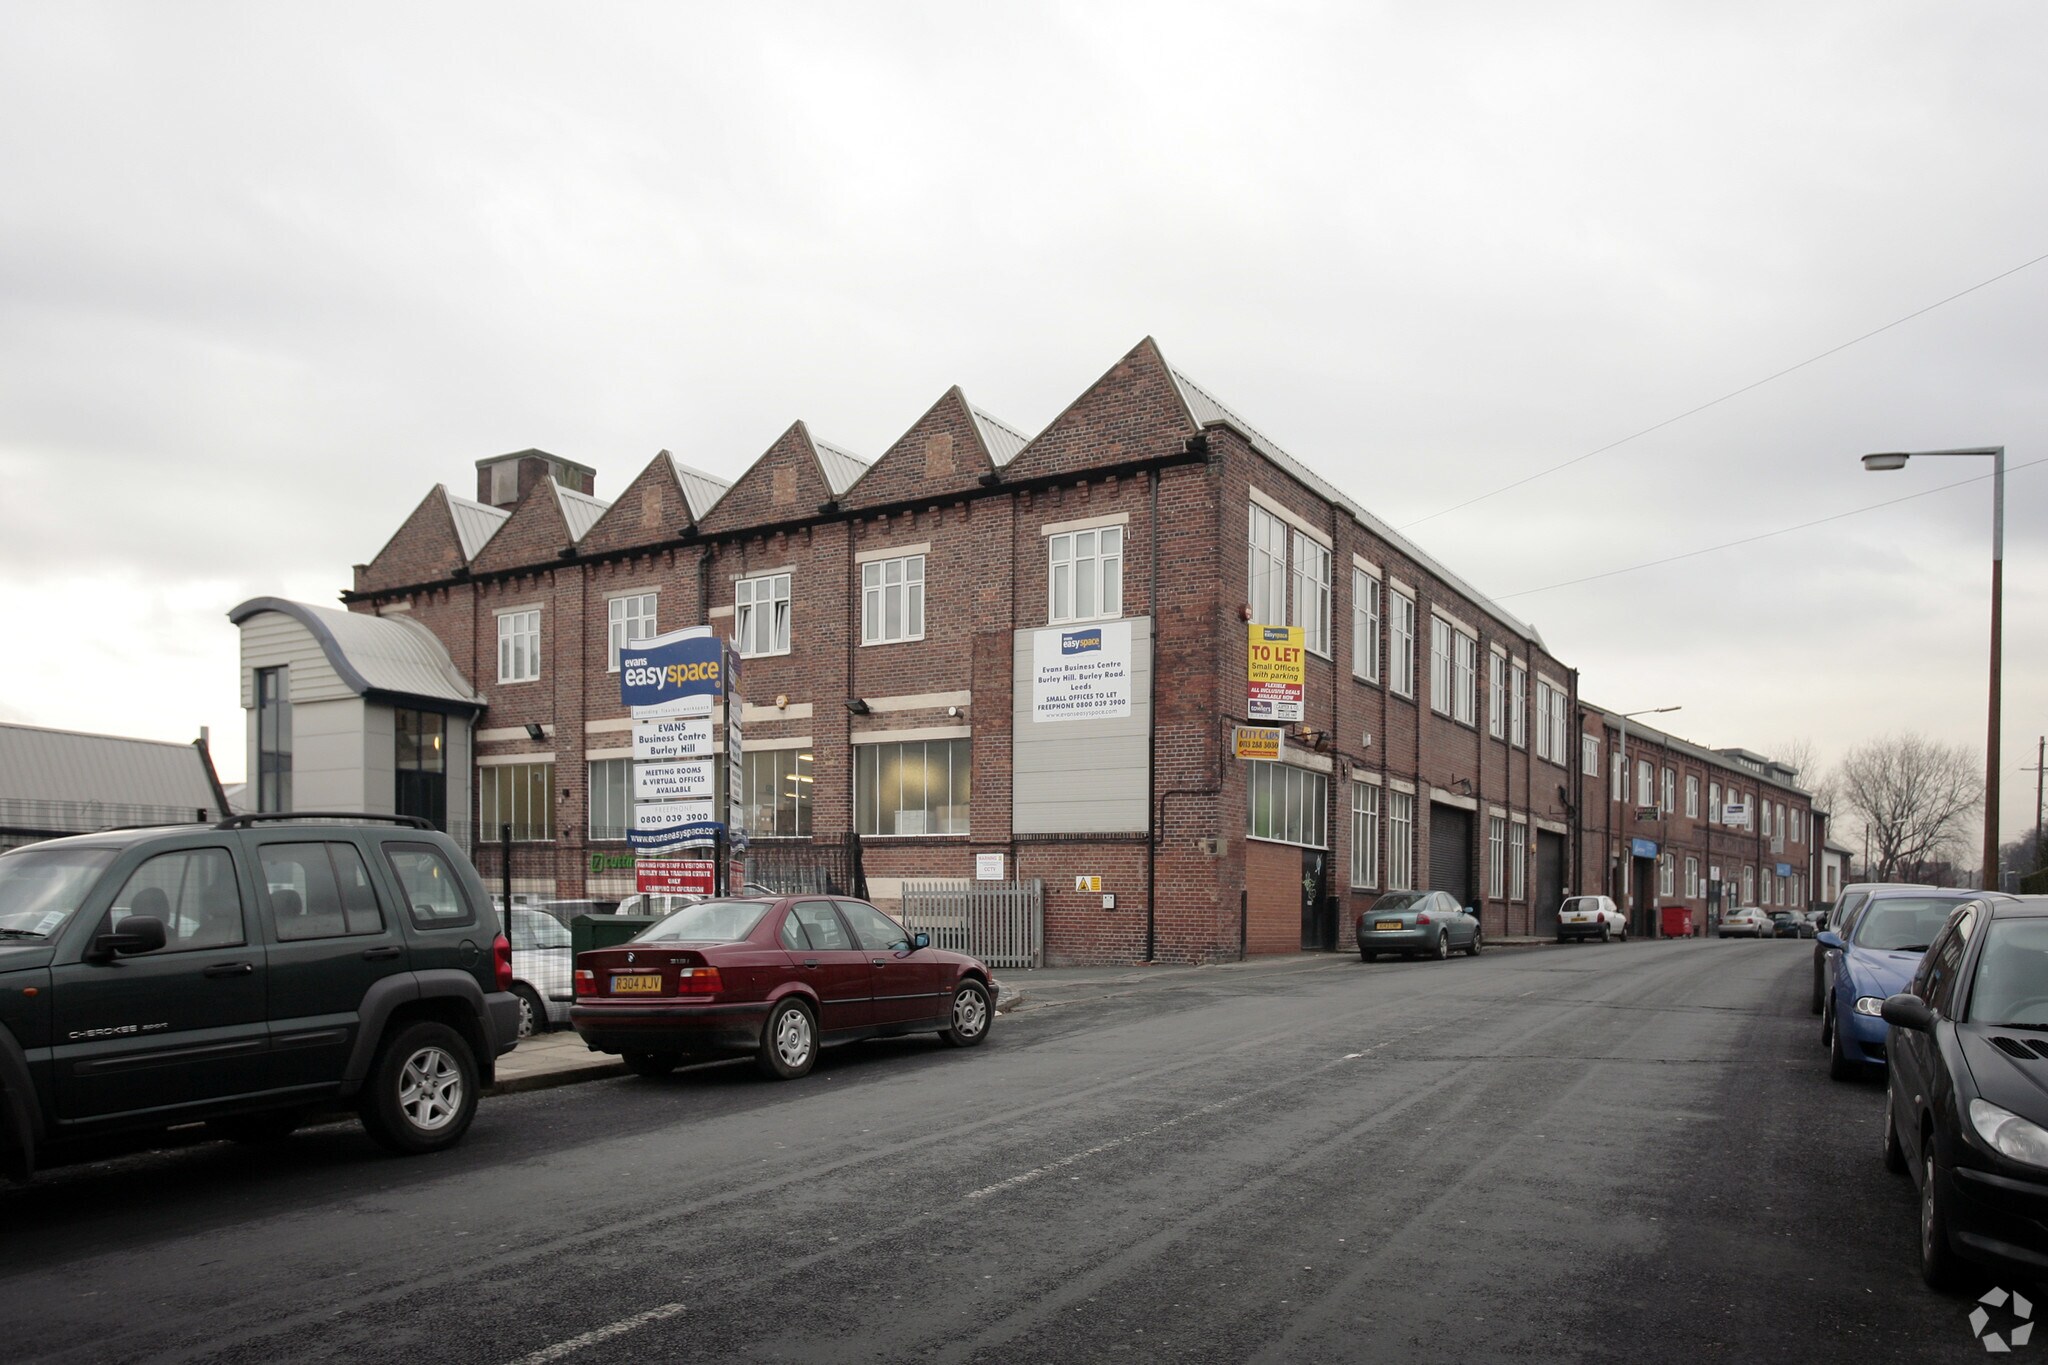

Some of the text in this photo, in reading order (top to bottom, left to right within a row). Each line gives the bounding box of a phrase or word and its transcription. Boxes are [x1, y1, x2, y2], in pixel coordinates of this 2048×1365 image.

[1063, 638, 1099, 649] easyspace
[1252, 646, 1300, 662] TO LET
[625, 658, 648, 667] evans
[1274, 664, 1300, 672] Offices
[625, 662, 719, 690] easyspace
[1270, 673, 1298, 681] parking
[658, 722, 686, 732] EVANS
[639, 734, 674, 744] Business
[651, 744, 695, 755] Burley Hill
[655, 805, 692, 813] FREEPHONE
[616, 978, 659, 990] R304 AJV
[69, 1025, 137, 1039] CHEROKEE
